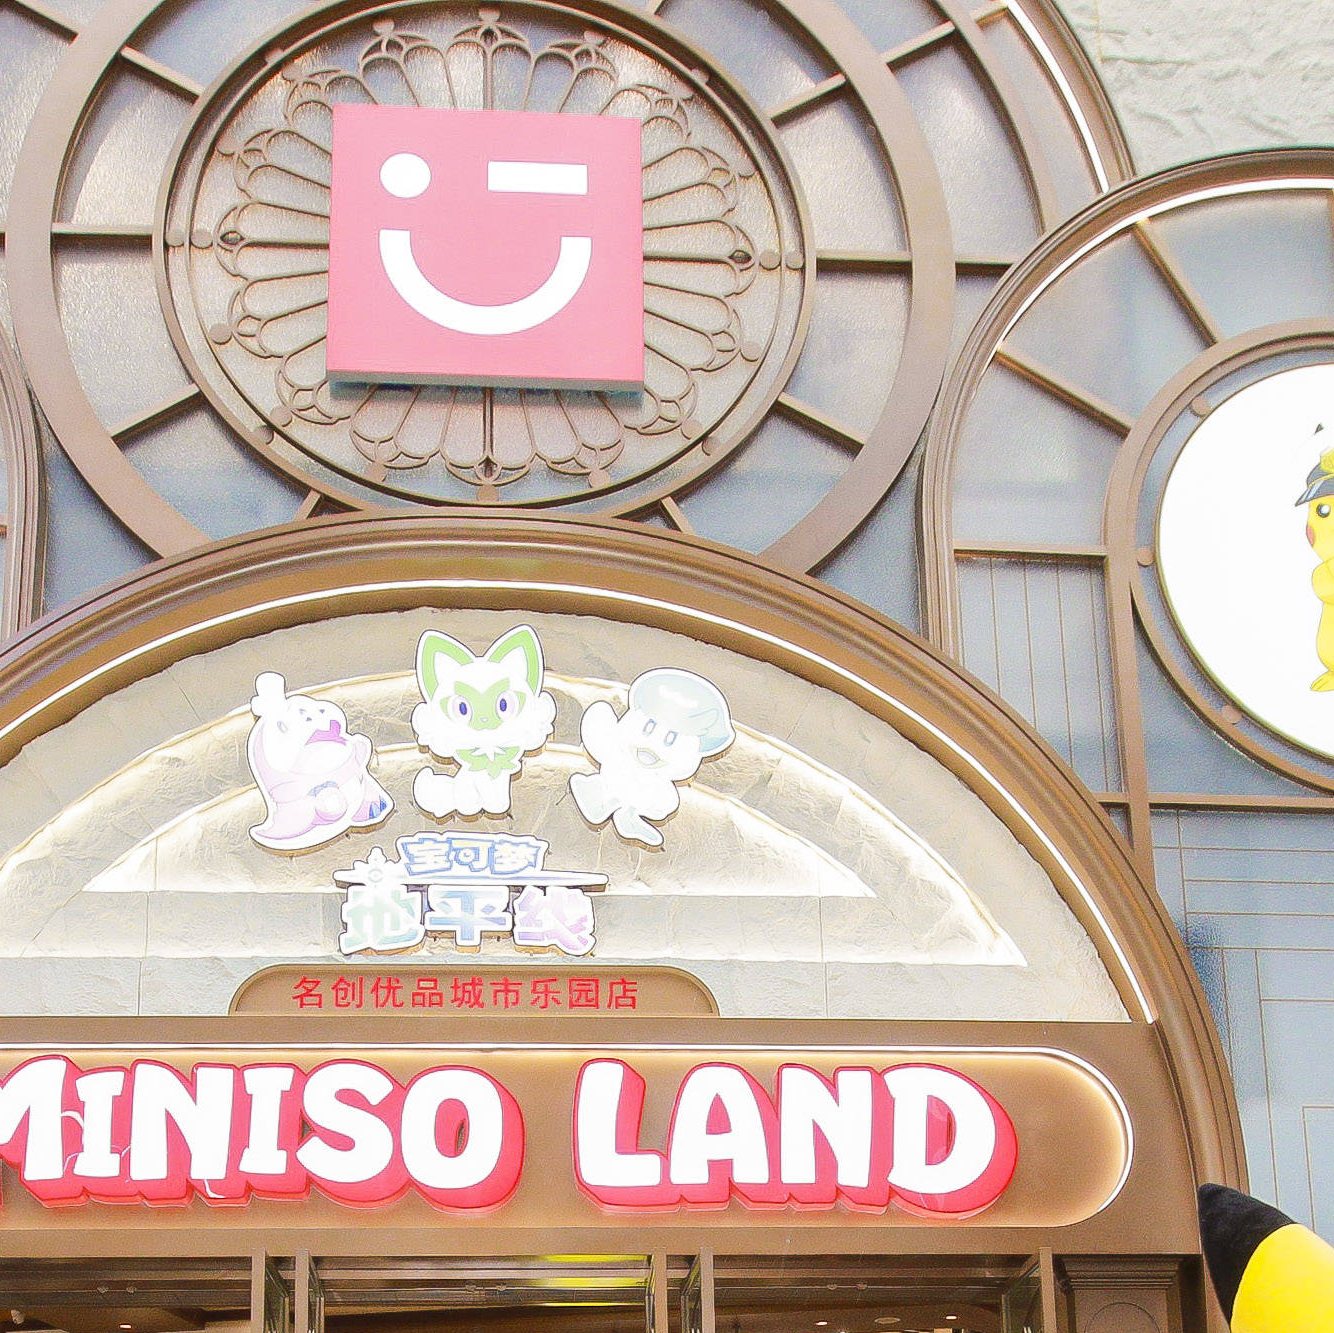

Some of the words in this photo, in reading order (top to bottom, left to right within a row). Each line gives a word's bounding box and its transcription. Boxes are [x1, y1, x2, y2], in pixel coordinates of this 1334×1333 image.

[402, 837, 542, 877] 宝可梦
[343, 888, 589, 951] 地平线
[292, 976, 639, 1010] 名创优品城市乐园店
[575, 1058, 1014, 1211] LAND
